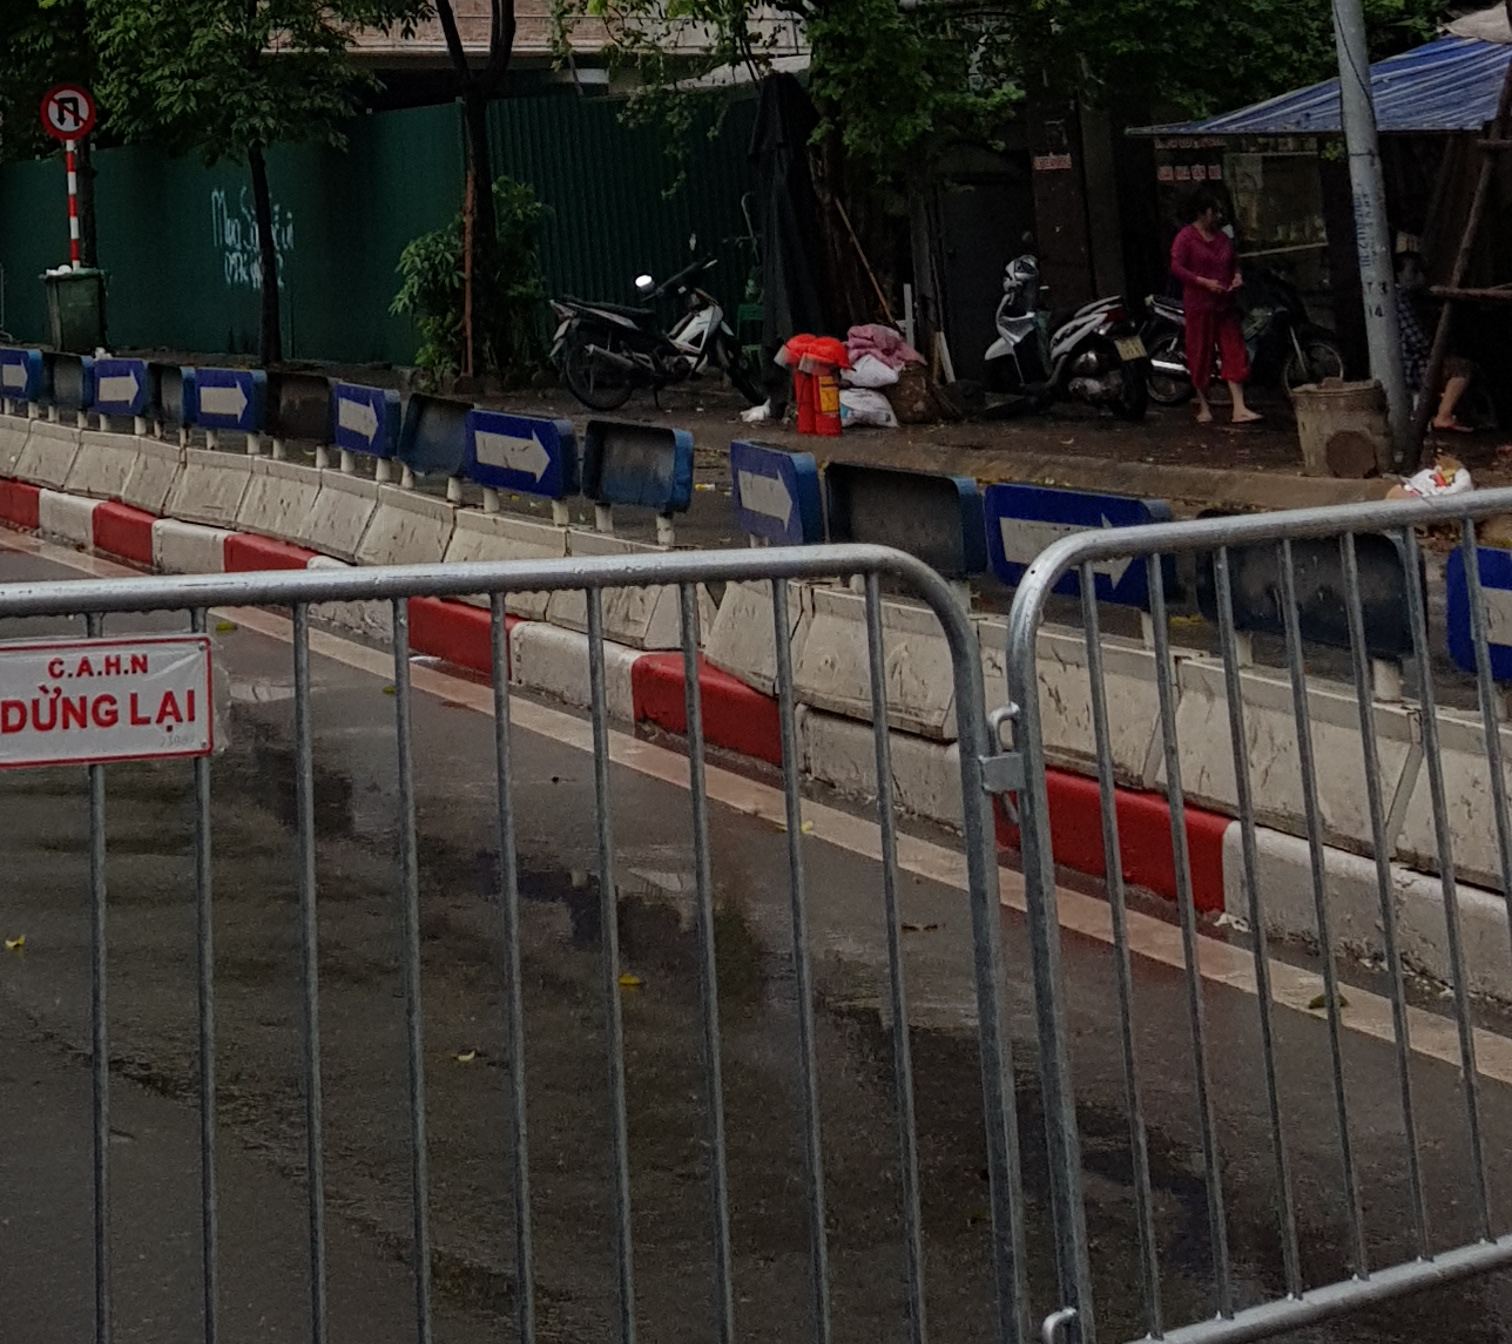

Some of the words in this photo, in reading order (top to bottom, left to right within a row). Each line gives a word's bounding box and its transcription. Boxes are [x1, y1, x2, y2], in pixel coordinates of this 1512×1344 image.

[48, 654, 148, 679] C.A.H.N
[0, 684, 119, 734] DỪNG
[130, 689, 196, 732] LẠI
